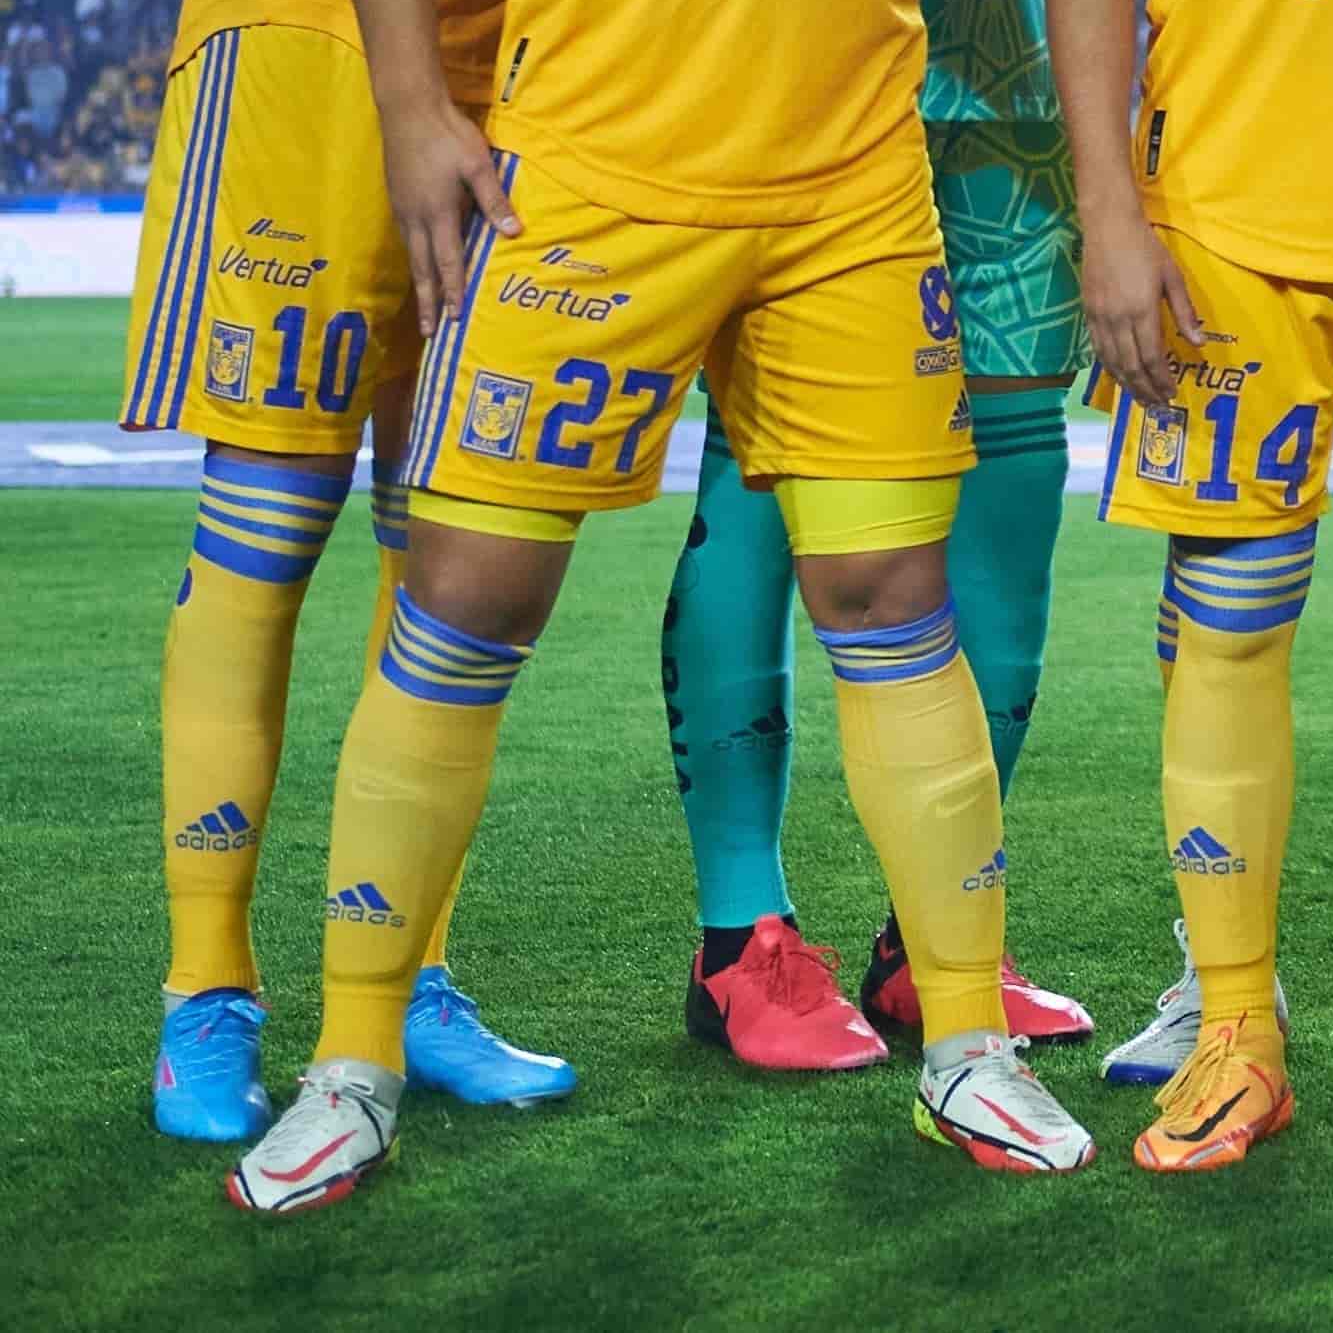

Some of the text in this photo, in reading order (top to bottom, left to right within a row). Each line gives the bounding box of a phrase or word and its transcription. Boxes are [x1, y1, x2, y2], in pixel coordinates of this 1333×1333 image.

[218, 244, 314, 289] Vertua
[499, 272, 613, 322] Vertua
[262, 305, 369, 413] 10
[1168, 352, 1246, 392] ertua
[535, 357, 675, 474] 27
[1196, 394, 1319, 507] 14
[175, 826, 258, 852] adidas
